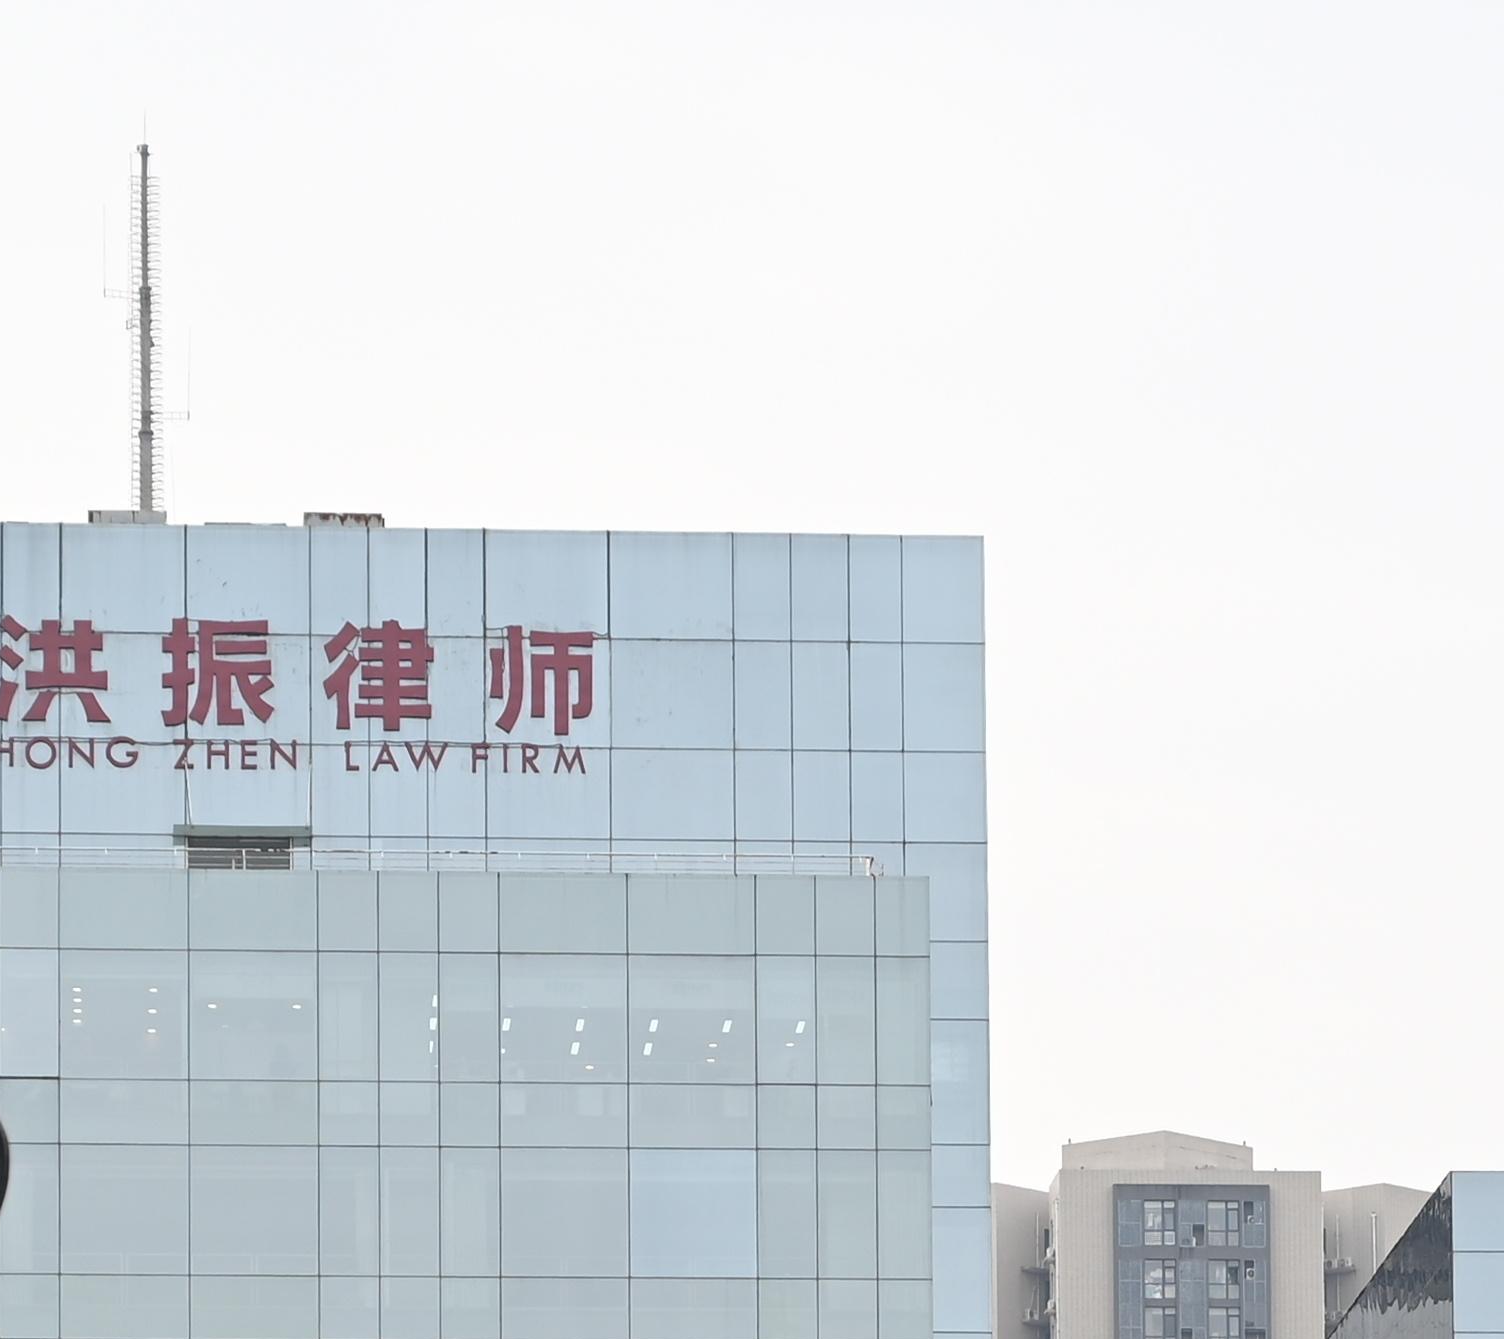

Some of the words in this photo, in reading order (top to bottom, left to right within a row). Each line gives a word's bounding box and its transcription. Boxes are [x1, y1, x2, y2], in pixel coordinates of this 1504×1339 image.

[173, 738, 300, 772] ZHEN
[345, 740, 449, 774] LAW
[470, 743, 588, 776] FIRM
